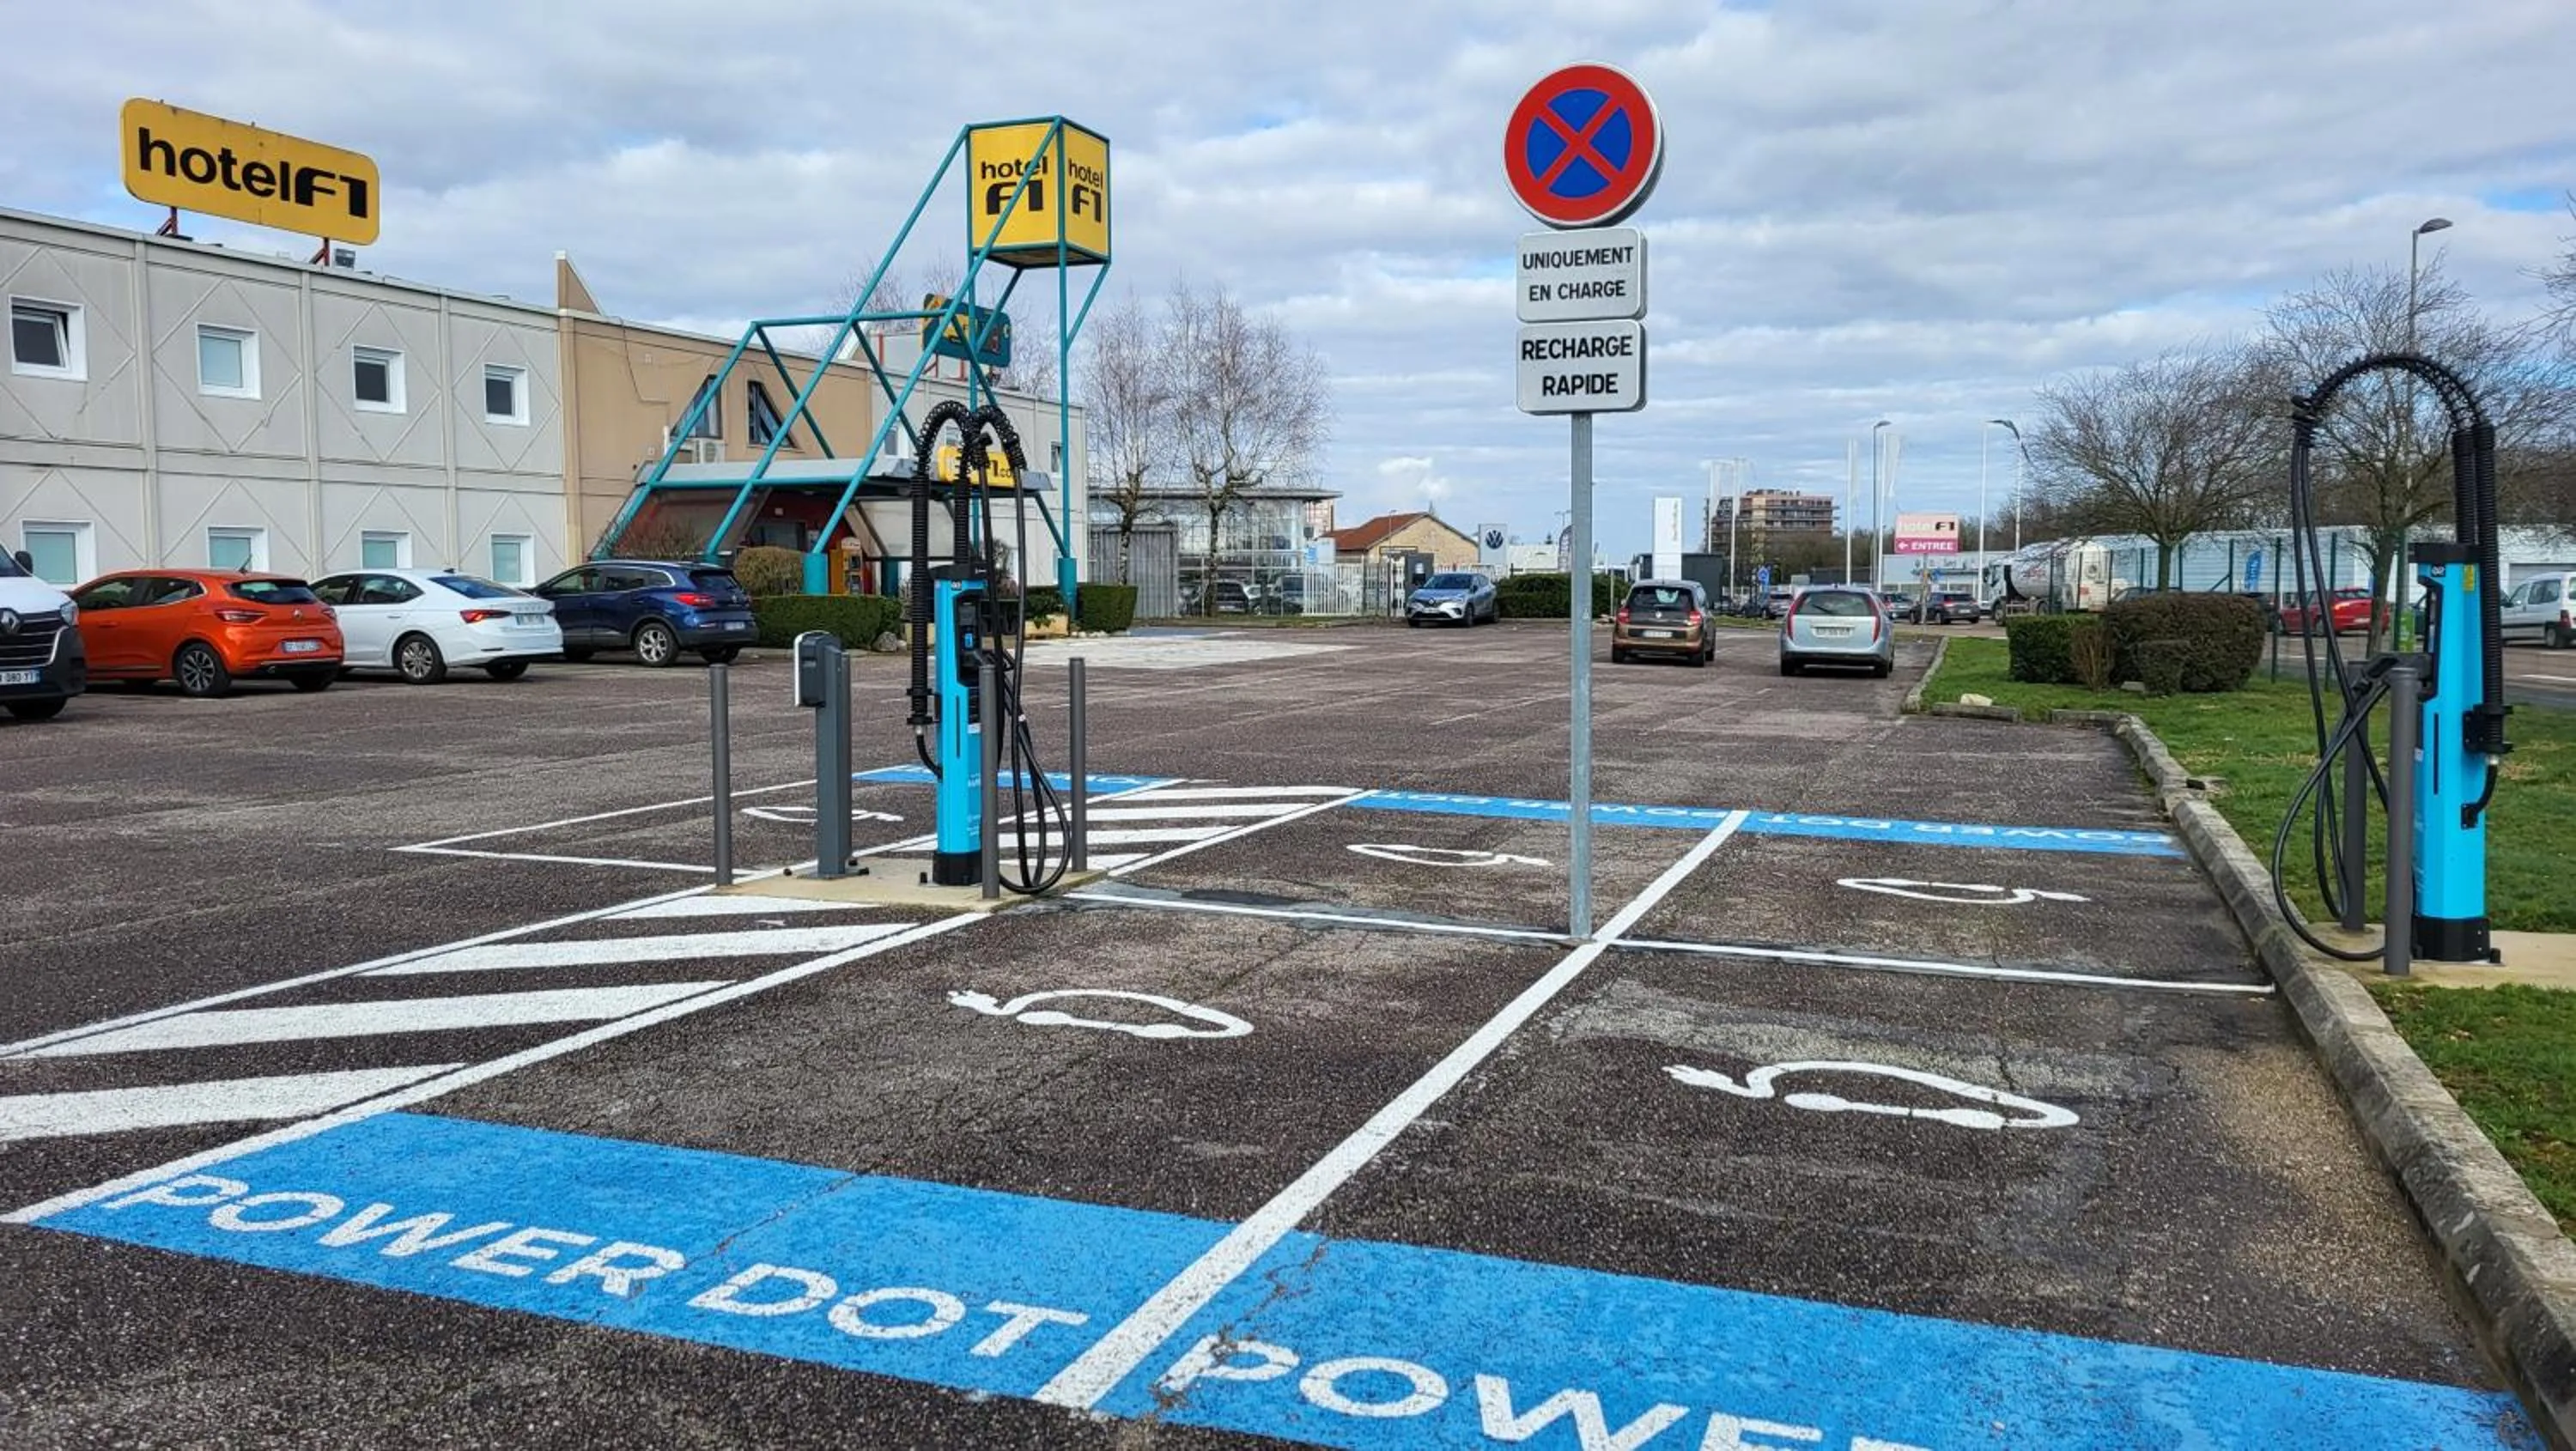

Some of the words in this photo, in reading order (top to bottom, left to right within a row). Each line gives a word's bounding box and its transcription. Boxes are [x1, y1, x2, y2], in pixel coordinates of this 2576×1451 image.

[981, 155, 1048, 179] hotel
[1068, 158, 1103, 190] hotel
[986, 179, 1043, 216] F1
[1072, 183, 1101, 223] F1
[1522, 246, 1633, 270] UNIQUEMENT
[1528, 284, 1552, 301] EN
[1558, 280, 1626, 301] CHARGE
[1522, 336, 1633, 361] RECHARGE
[1542, 373, 1619, 396] RAPIDE
[104, 1174, 685, 1296] POWER
[687, 1263, 1090, 1357] DOT
[1156, 1335, 1933, 1451] POWE
